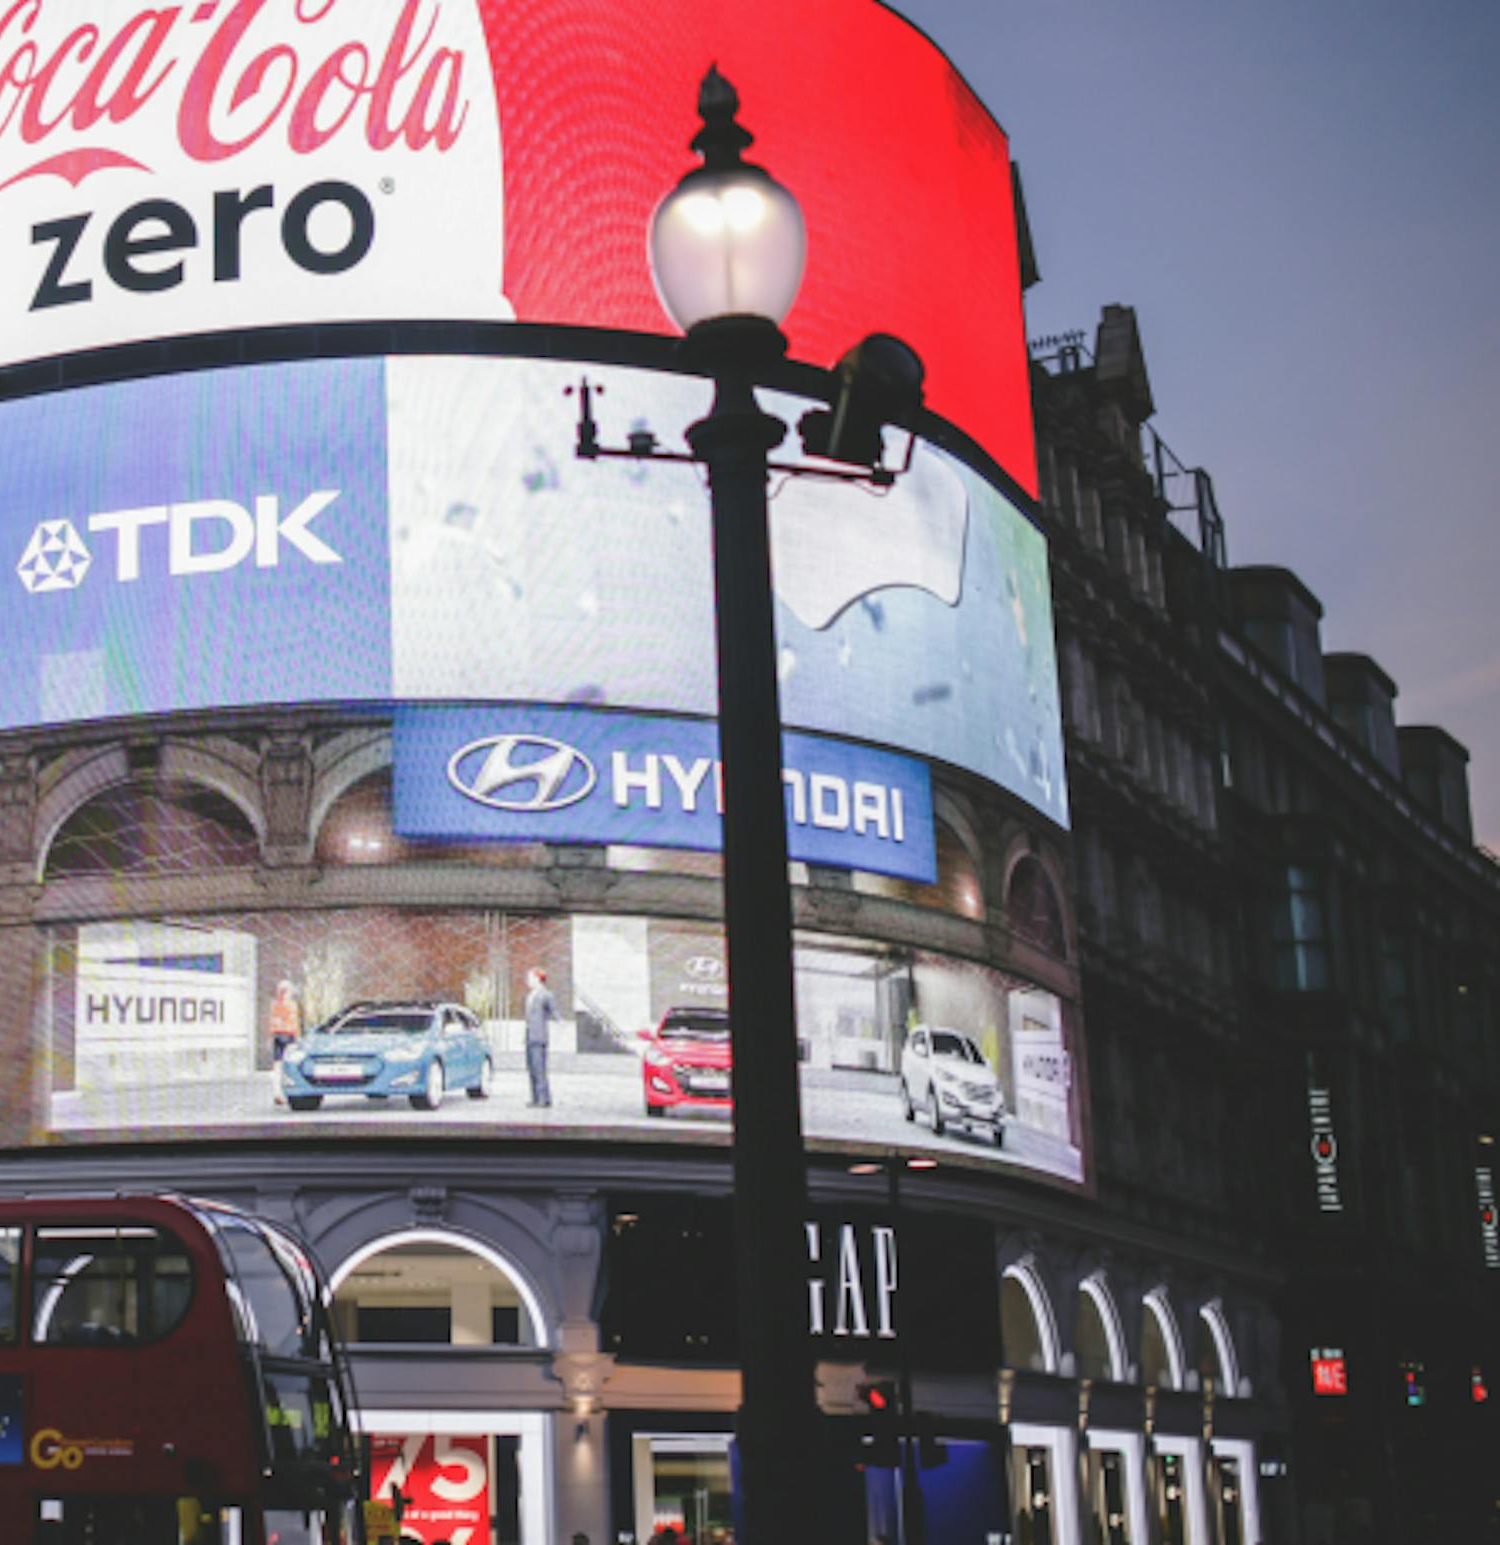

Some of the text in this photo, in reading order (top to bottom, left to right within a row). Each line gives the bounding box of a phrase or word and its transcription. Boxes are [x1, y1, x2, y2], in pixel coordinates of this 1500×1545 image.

[27, 178, 376, 312] zero
[89, 489, 343, 583] TDK
[610, 750, 904, 843] HYNDAI
[86, 992, 225, 1027] HYUNDAI
